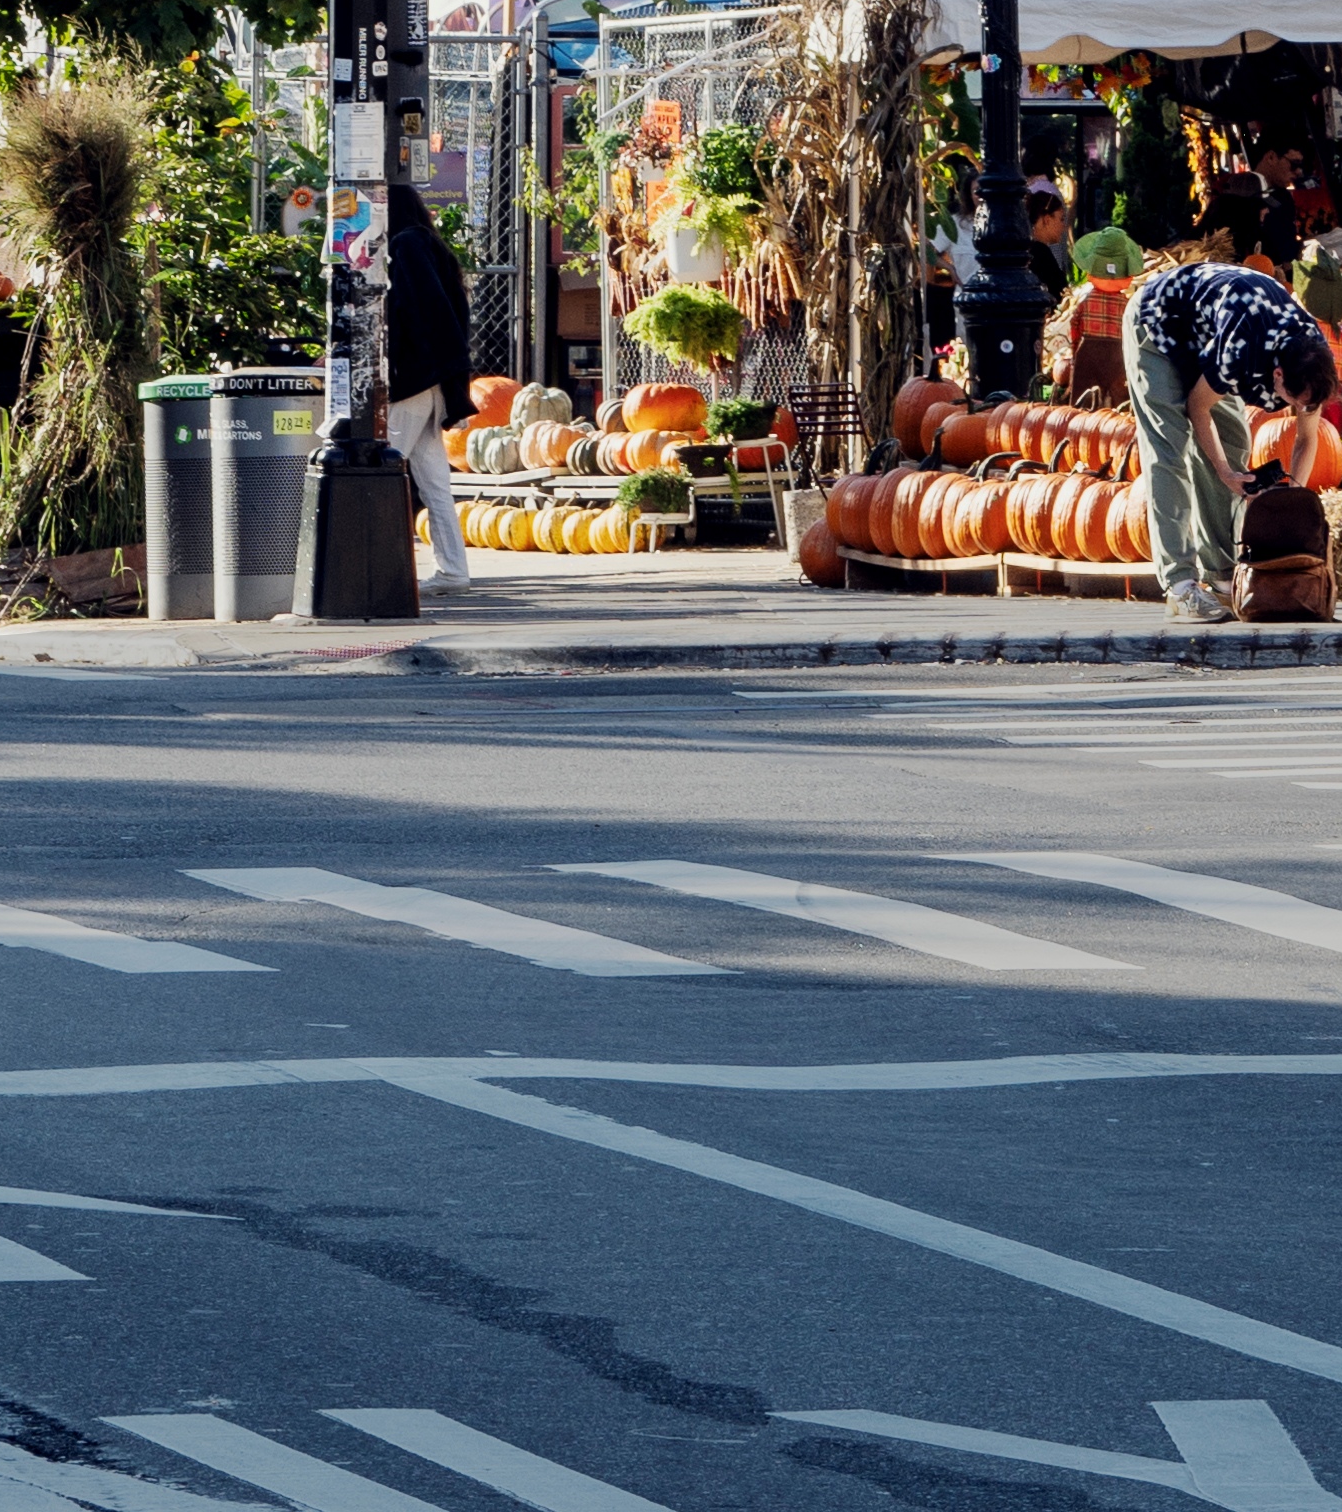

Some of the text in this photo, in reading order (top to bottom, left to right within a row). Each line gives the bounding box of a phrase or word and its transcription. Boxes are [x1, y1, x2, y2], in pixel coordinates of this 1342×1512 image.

[359, 60, 367, 100] RUNNING
[229, 378, 313, 390] DON'T LITTER
[156, 386, 211, 398] RECYCLE
